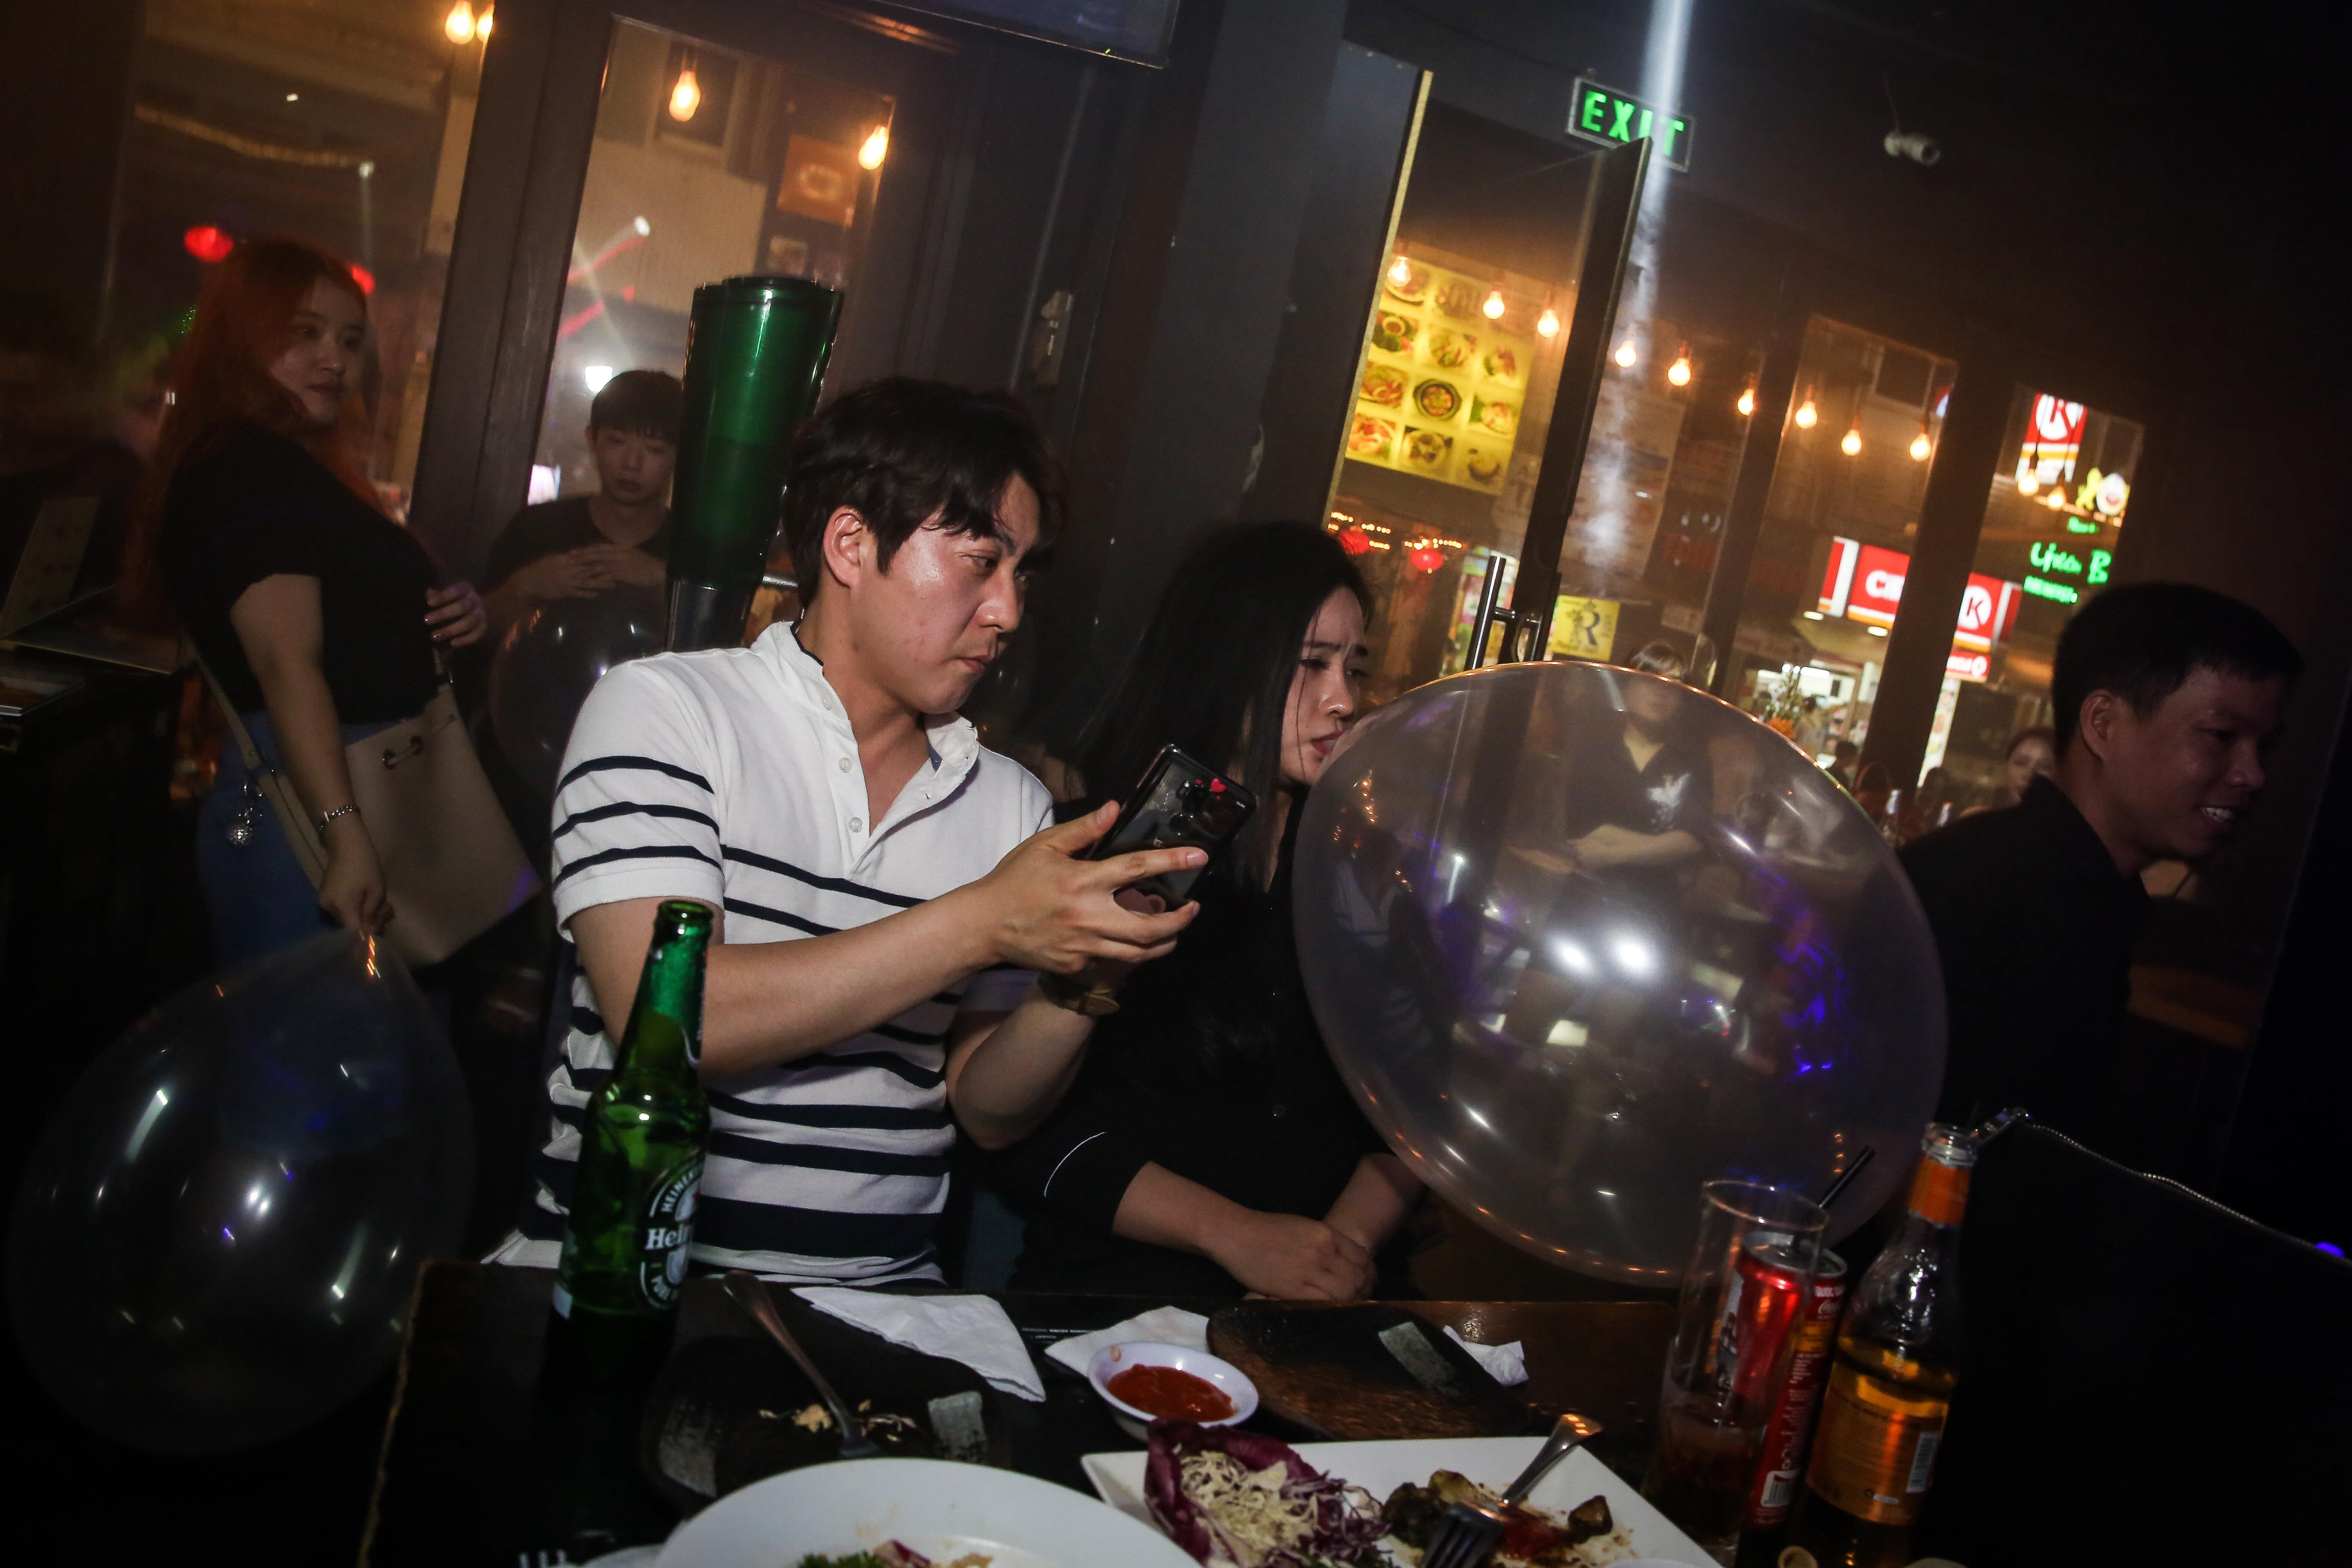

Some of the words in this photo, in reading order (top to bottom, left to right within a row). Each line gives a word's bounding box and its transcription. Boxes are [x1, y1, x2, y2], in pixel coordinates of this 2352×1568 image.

[1581, 90, 1685, 156] EXIT
[1966, 596, 1985, 627] K
[644, 1224, 688, 1250] Hei
